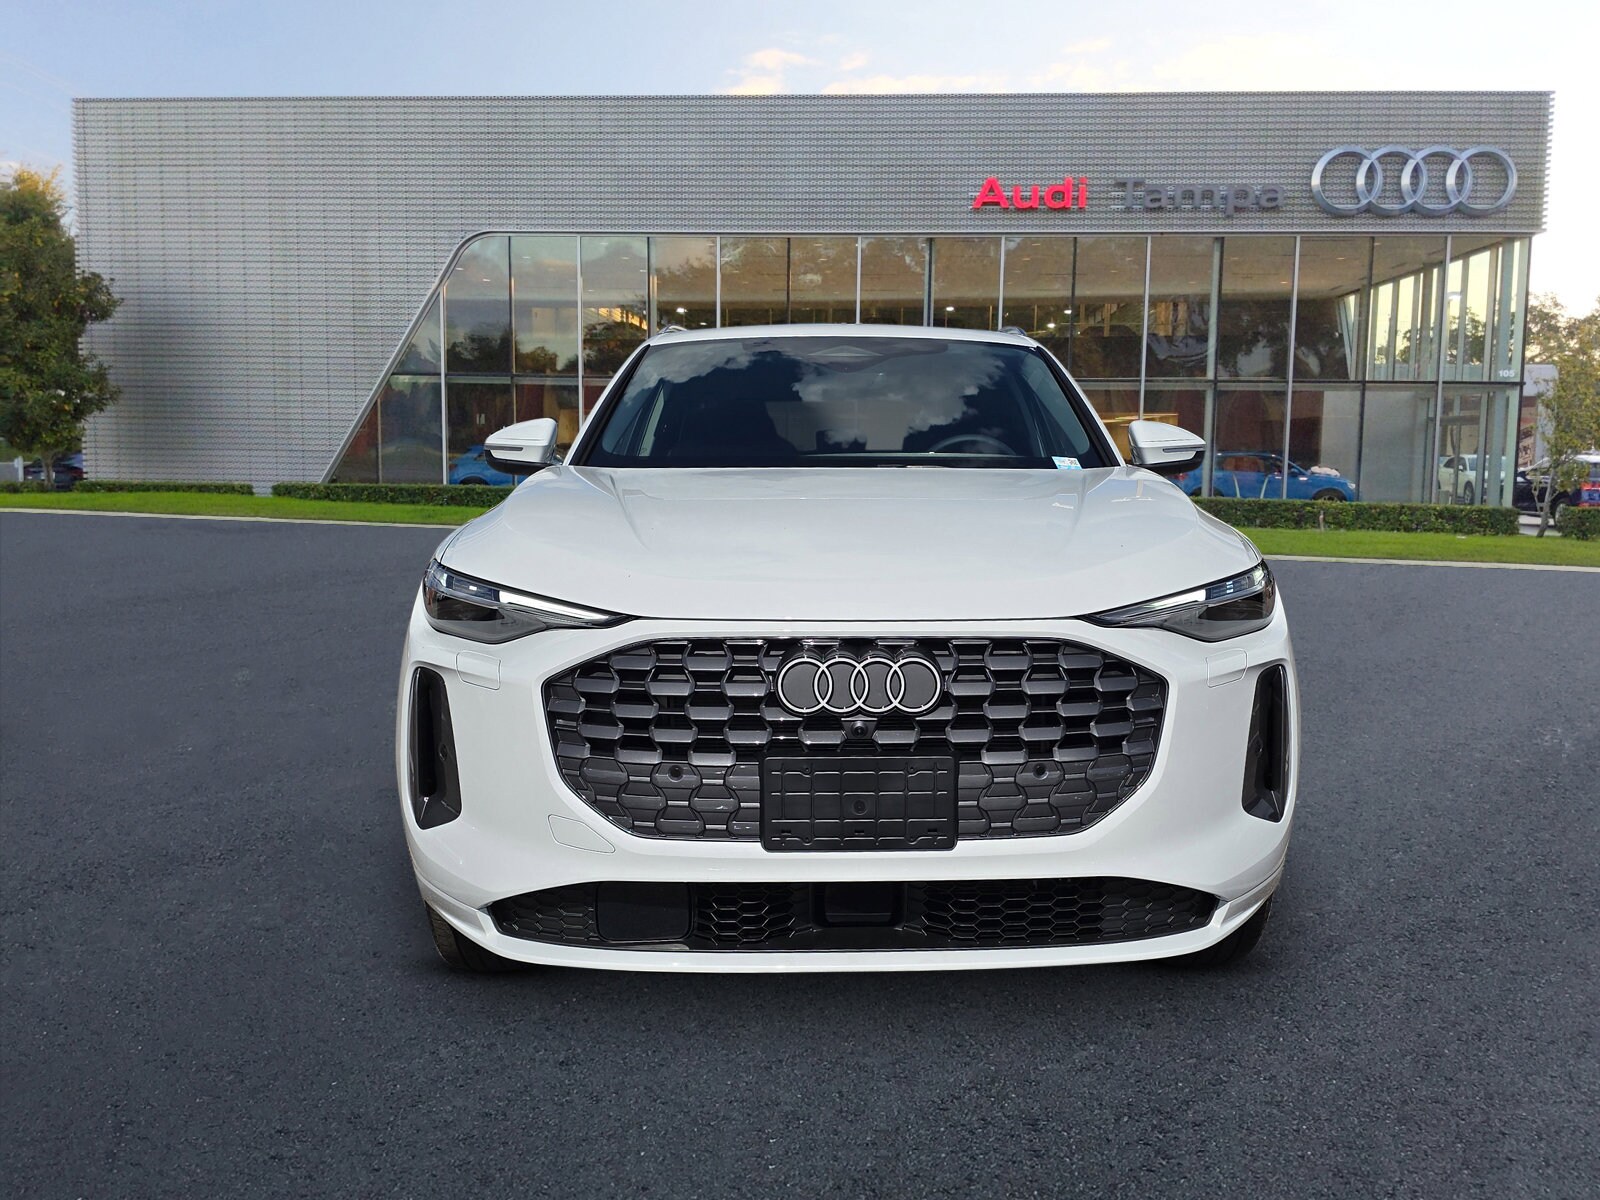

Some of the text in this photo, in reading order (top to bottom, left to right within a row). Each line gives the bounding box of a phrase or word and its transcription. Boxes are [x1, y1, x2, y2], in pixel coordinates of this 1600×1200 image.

[971, 176, 1286, 218] Audi Tampa
[1499, 369, 1515, 378] 105
